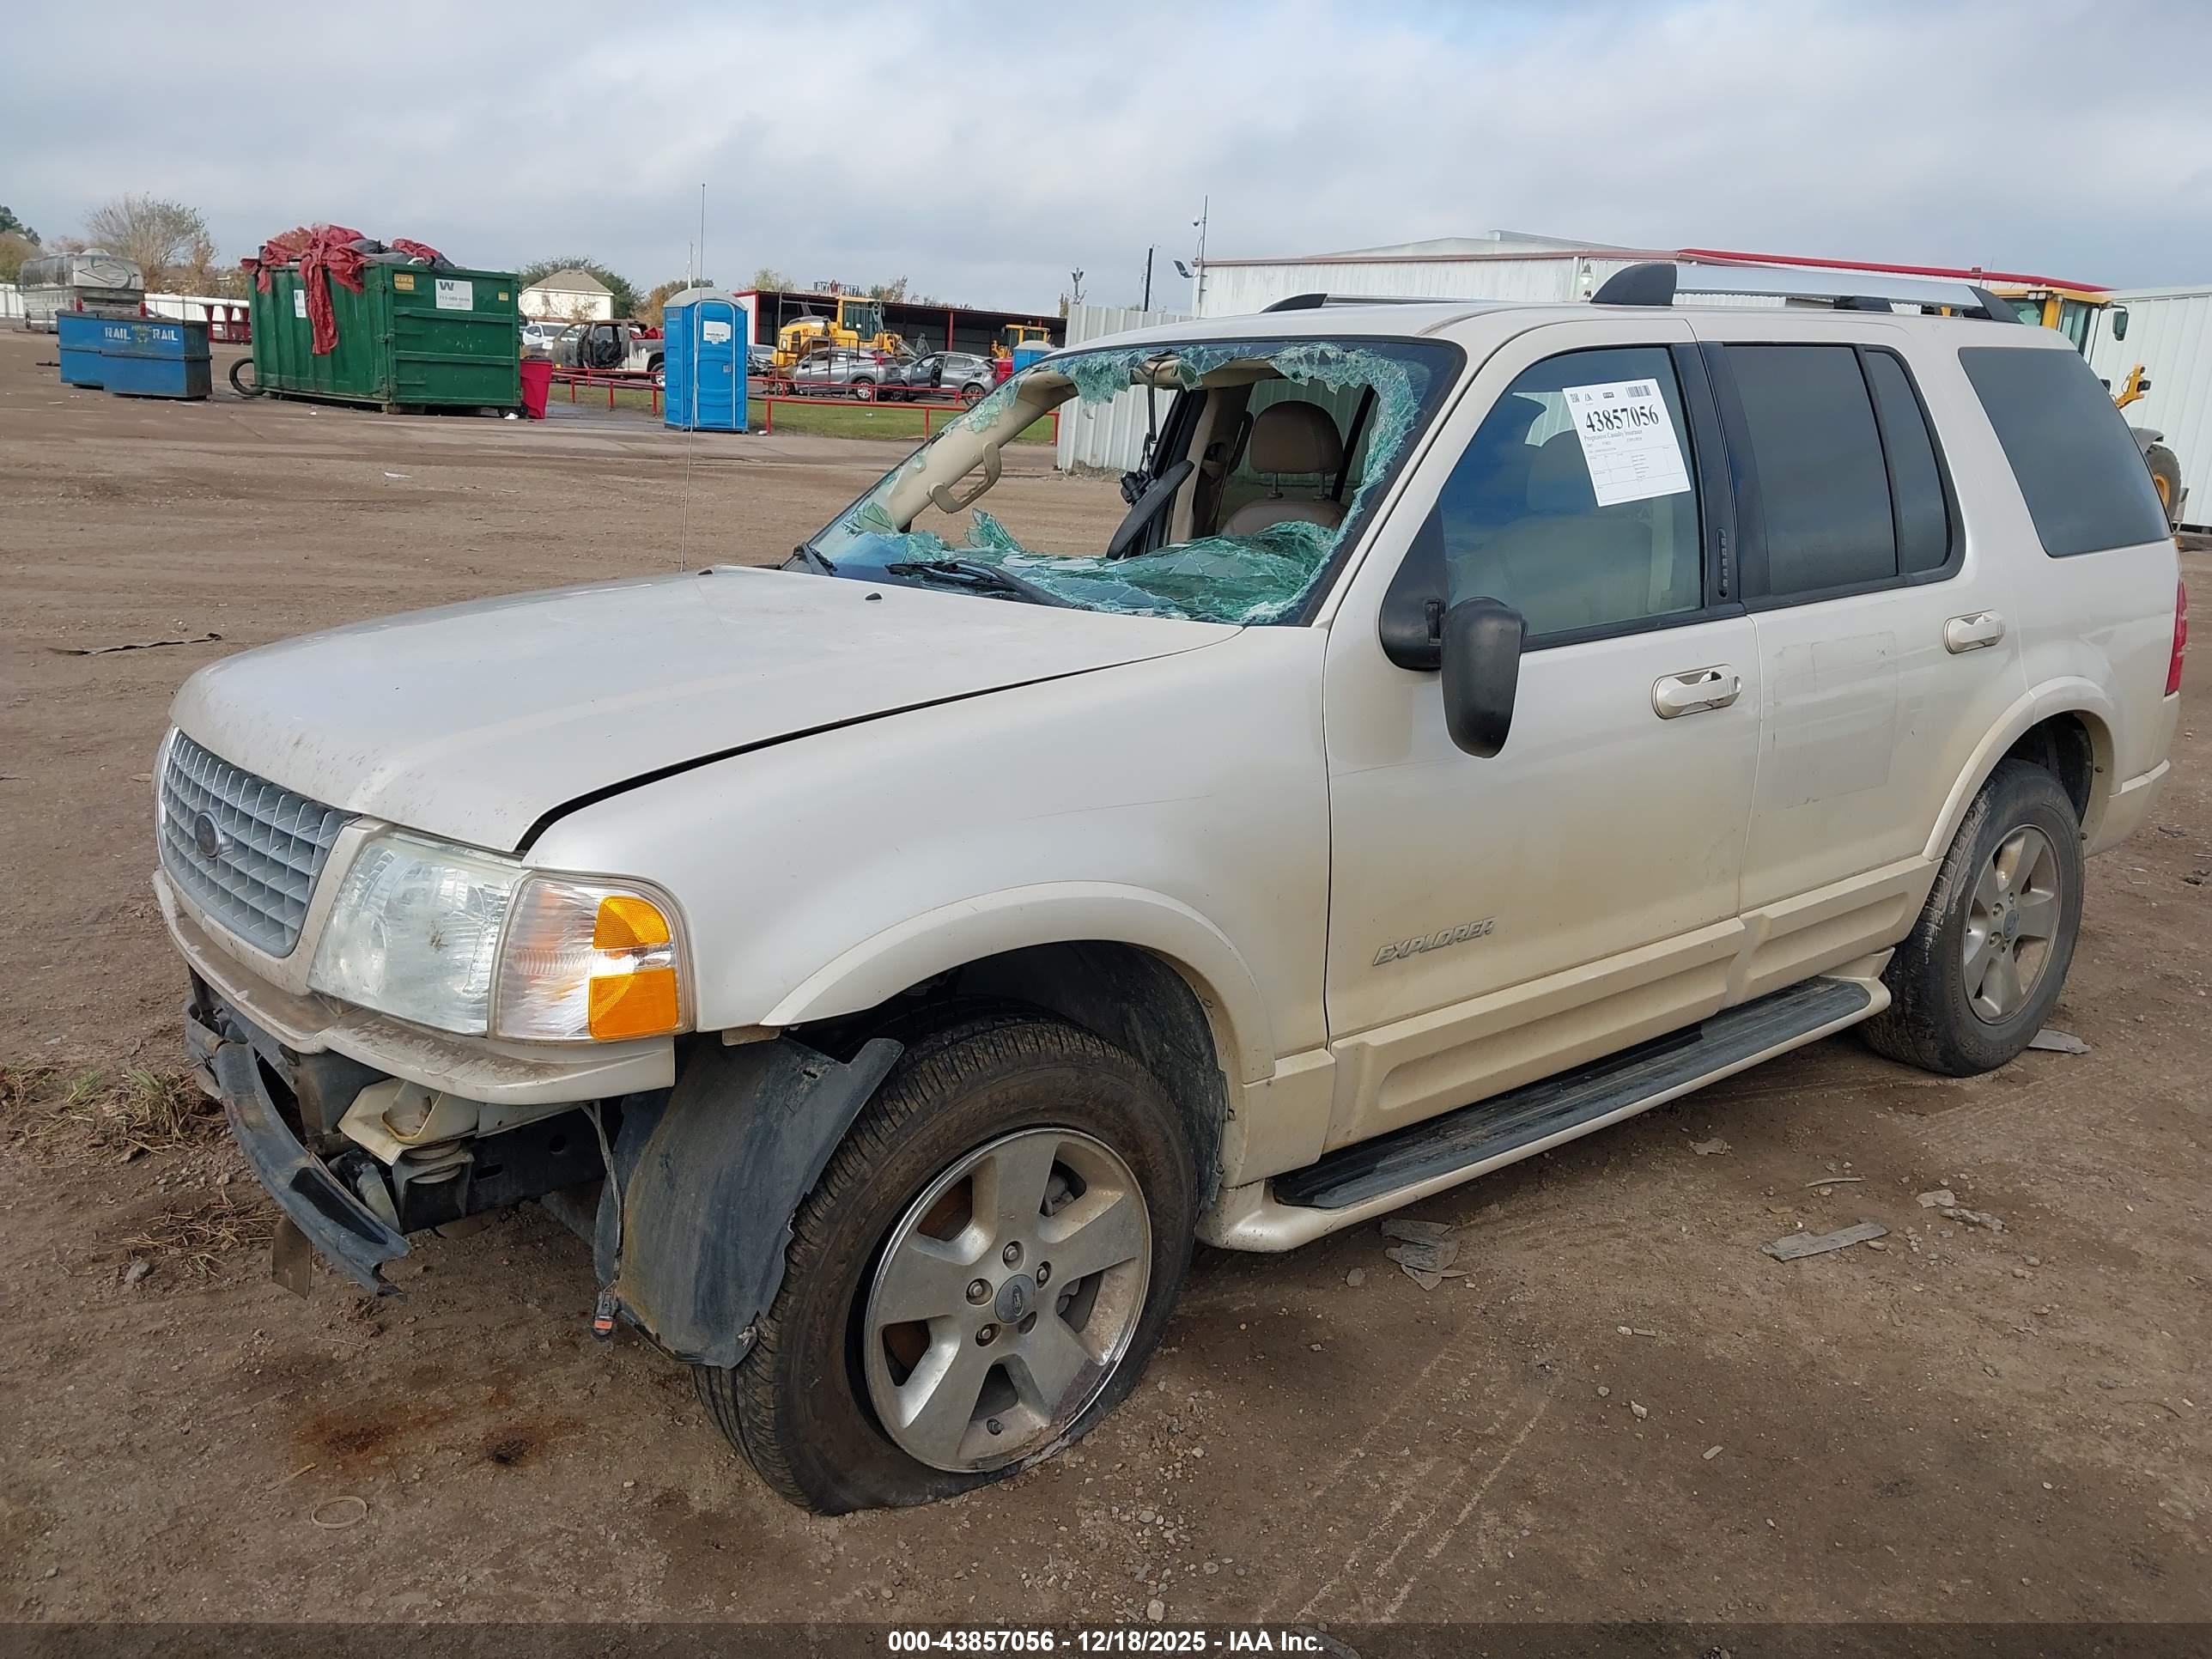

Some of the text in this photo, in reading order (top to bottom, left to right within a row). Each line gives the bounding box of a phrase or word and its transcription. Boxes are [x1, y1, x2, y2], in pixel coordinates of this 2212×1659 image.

[105, 327, 179, 341] RAIL RAIL
[1586, 404, 1659, 432] 43857056
[1373, 916, 1498, 966] EXPLORER
